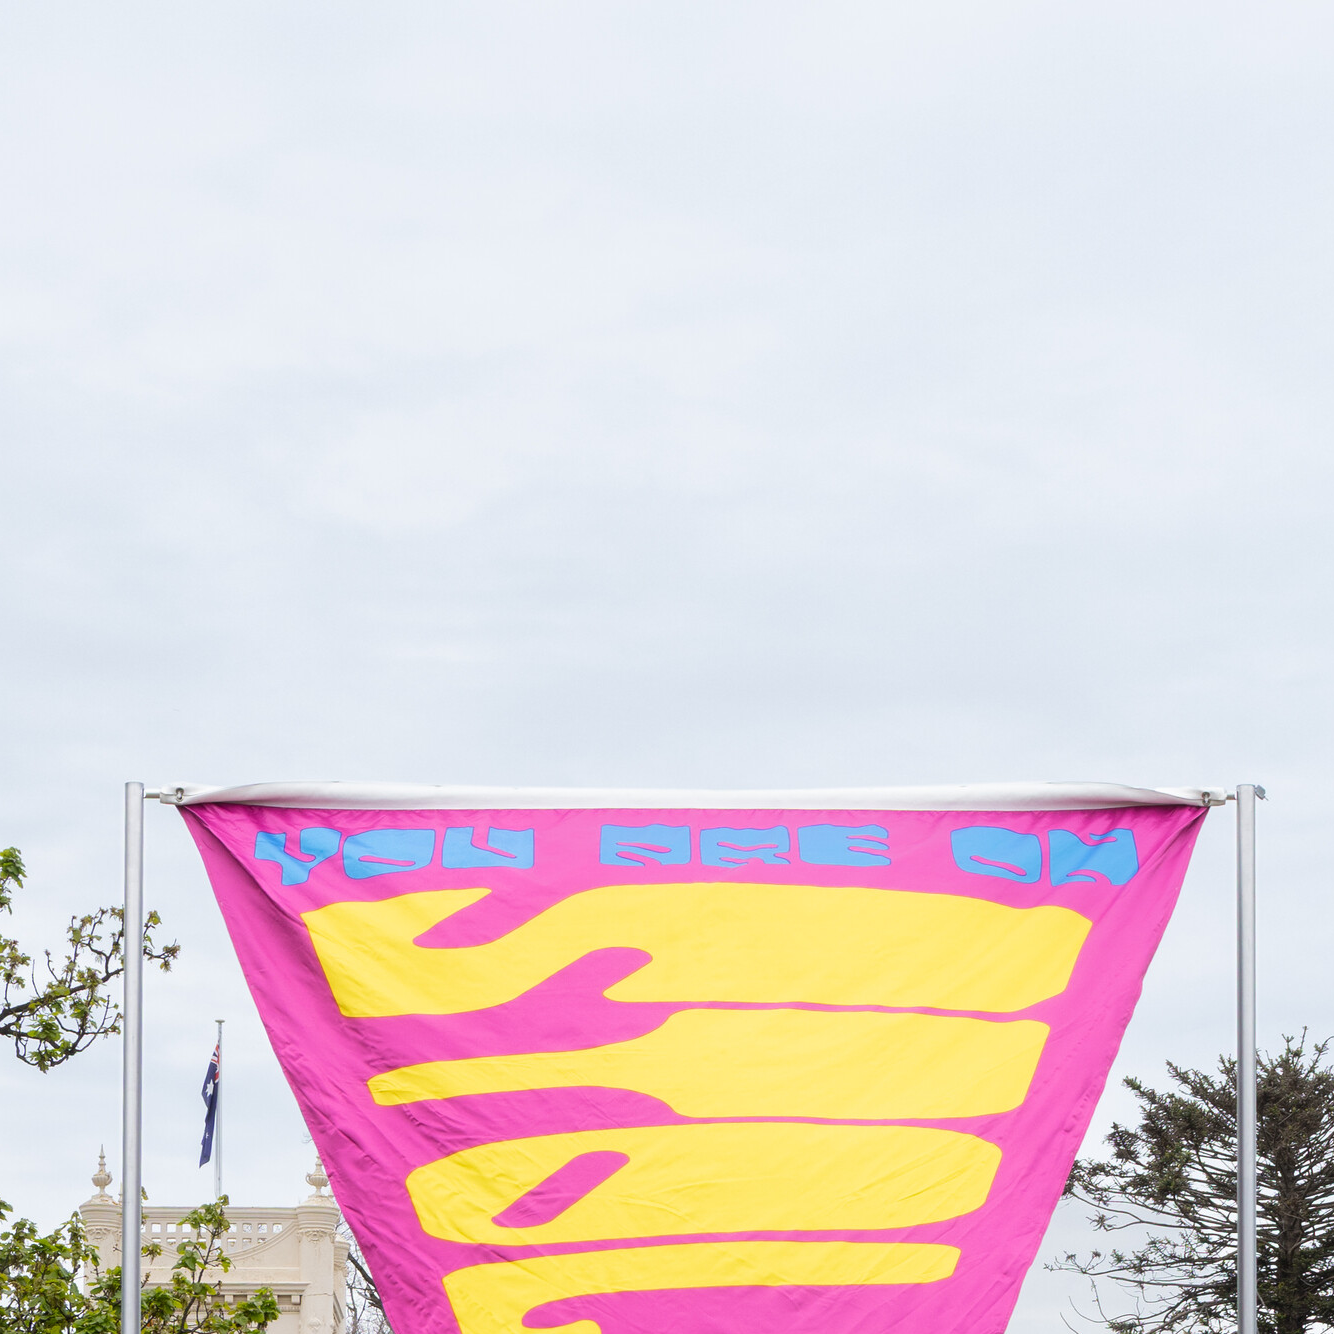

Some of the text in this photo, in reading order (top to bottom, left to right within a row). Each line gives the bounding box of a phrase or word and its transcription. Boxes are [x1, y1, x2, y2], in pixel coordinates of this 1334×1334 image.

[253, 823, 1140, 888] YOU ARE ON
